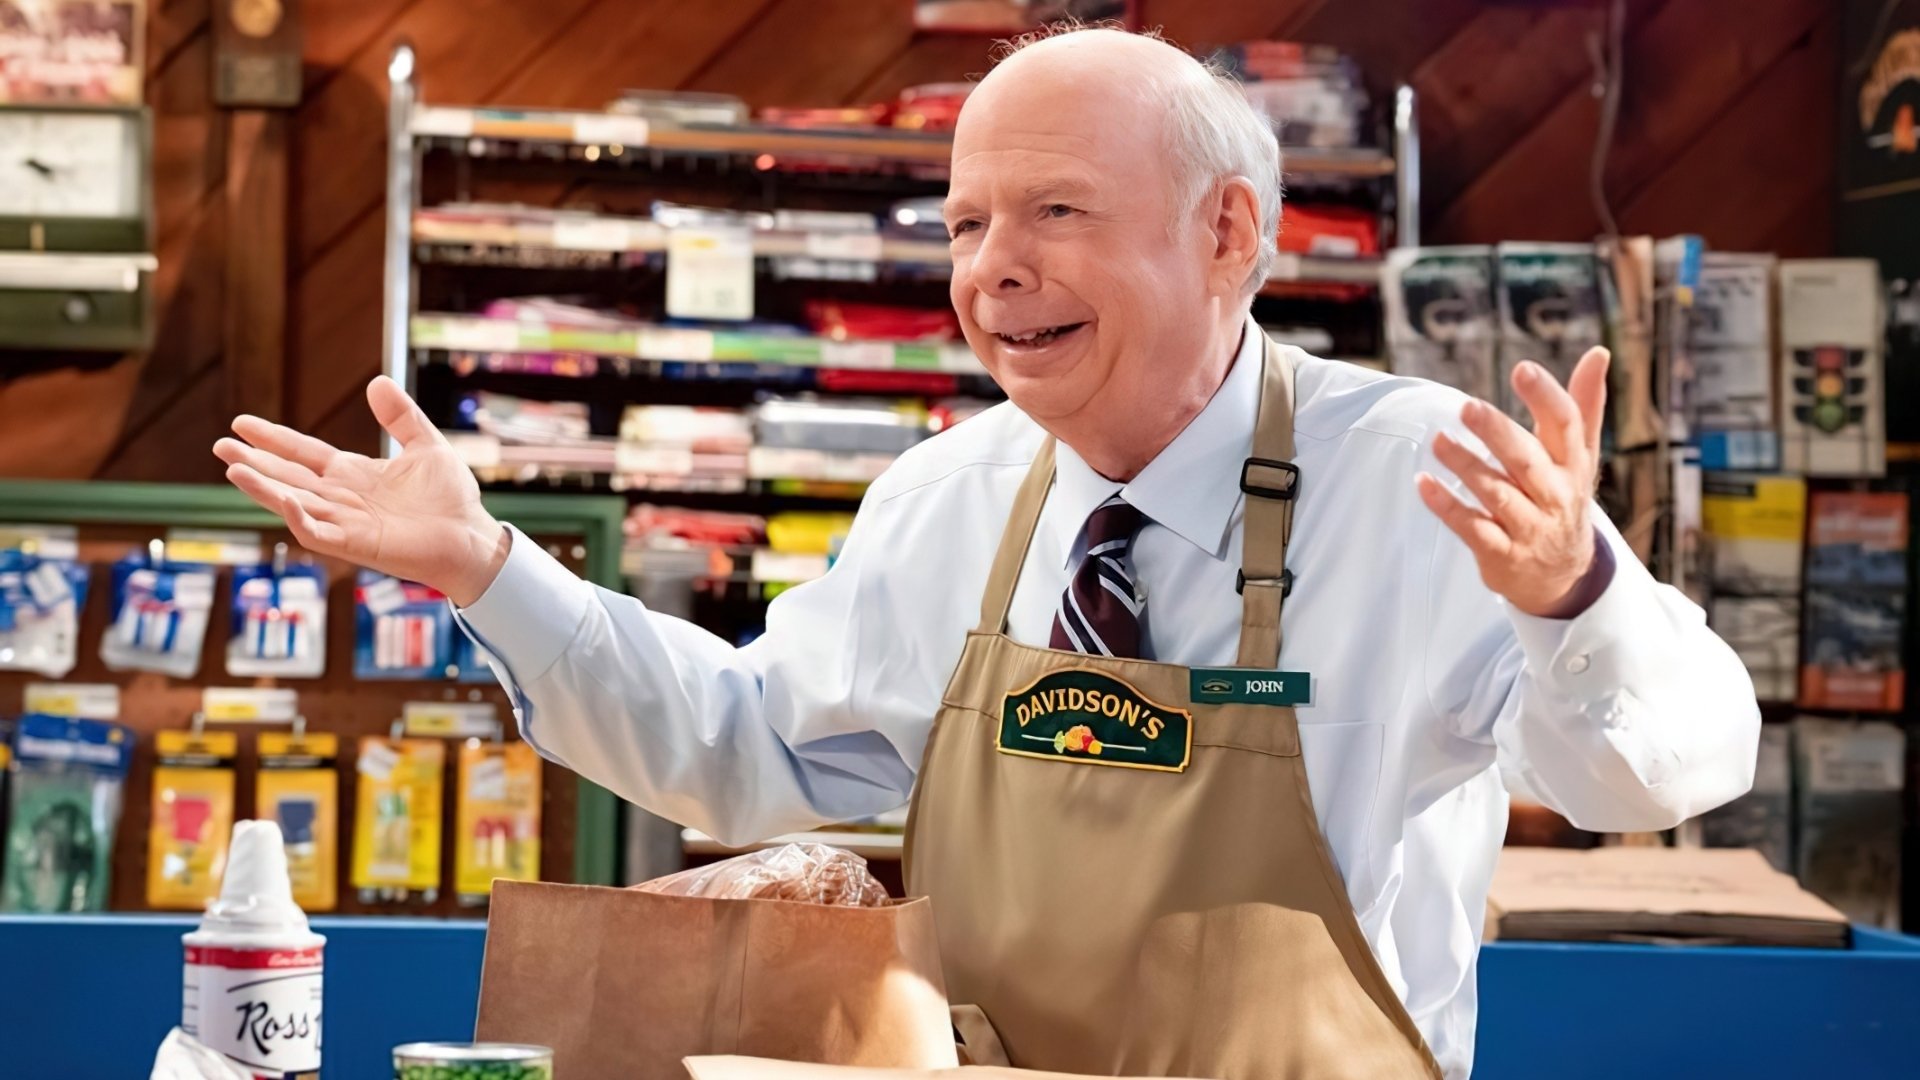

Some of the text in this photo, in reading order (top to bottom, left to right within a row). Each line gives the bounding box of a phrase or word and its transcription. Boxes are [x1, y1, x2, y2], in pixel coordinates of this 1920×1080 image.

[1016, 687, 1165, 740] DAVIDSON'S
[1245, 680, 1284, 694] JOHN
[235, 1000, 309, 1056] Ross
